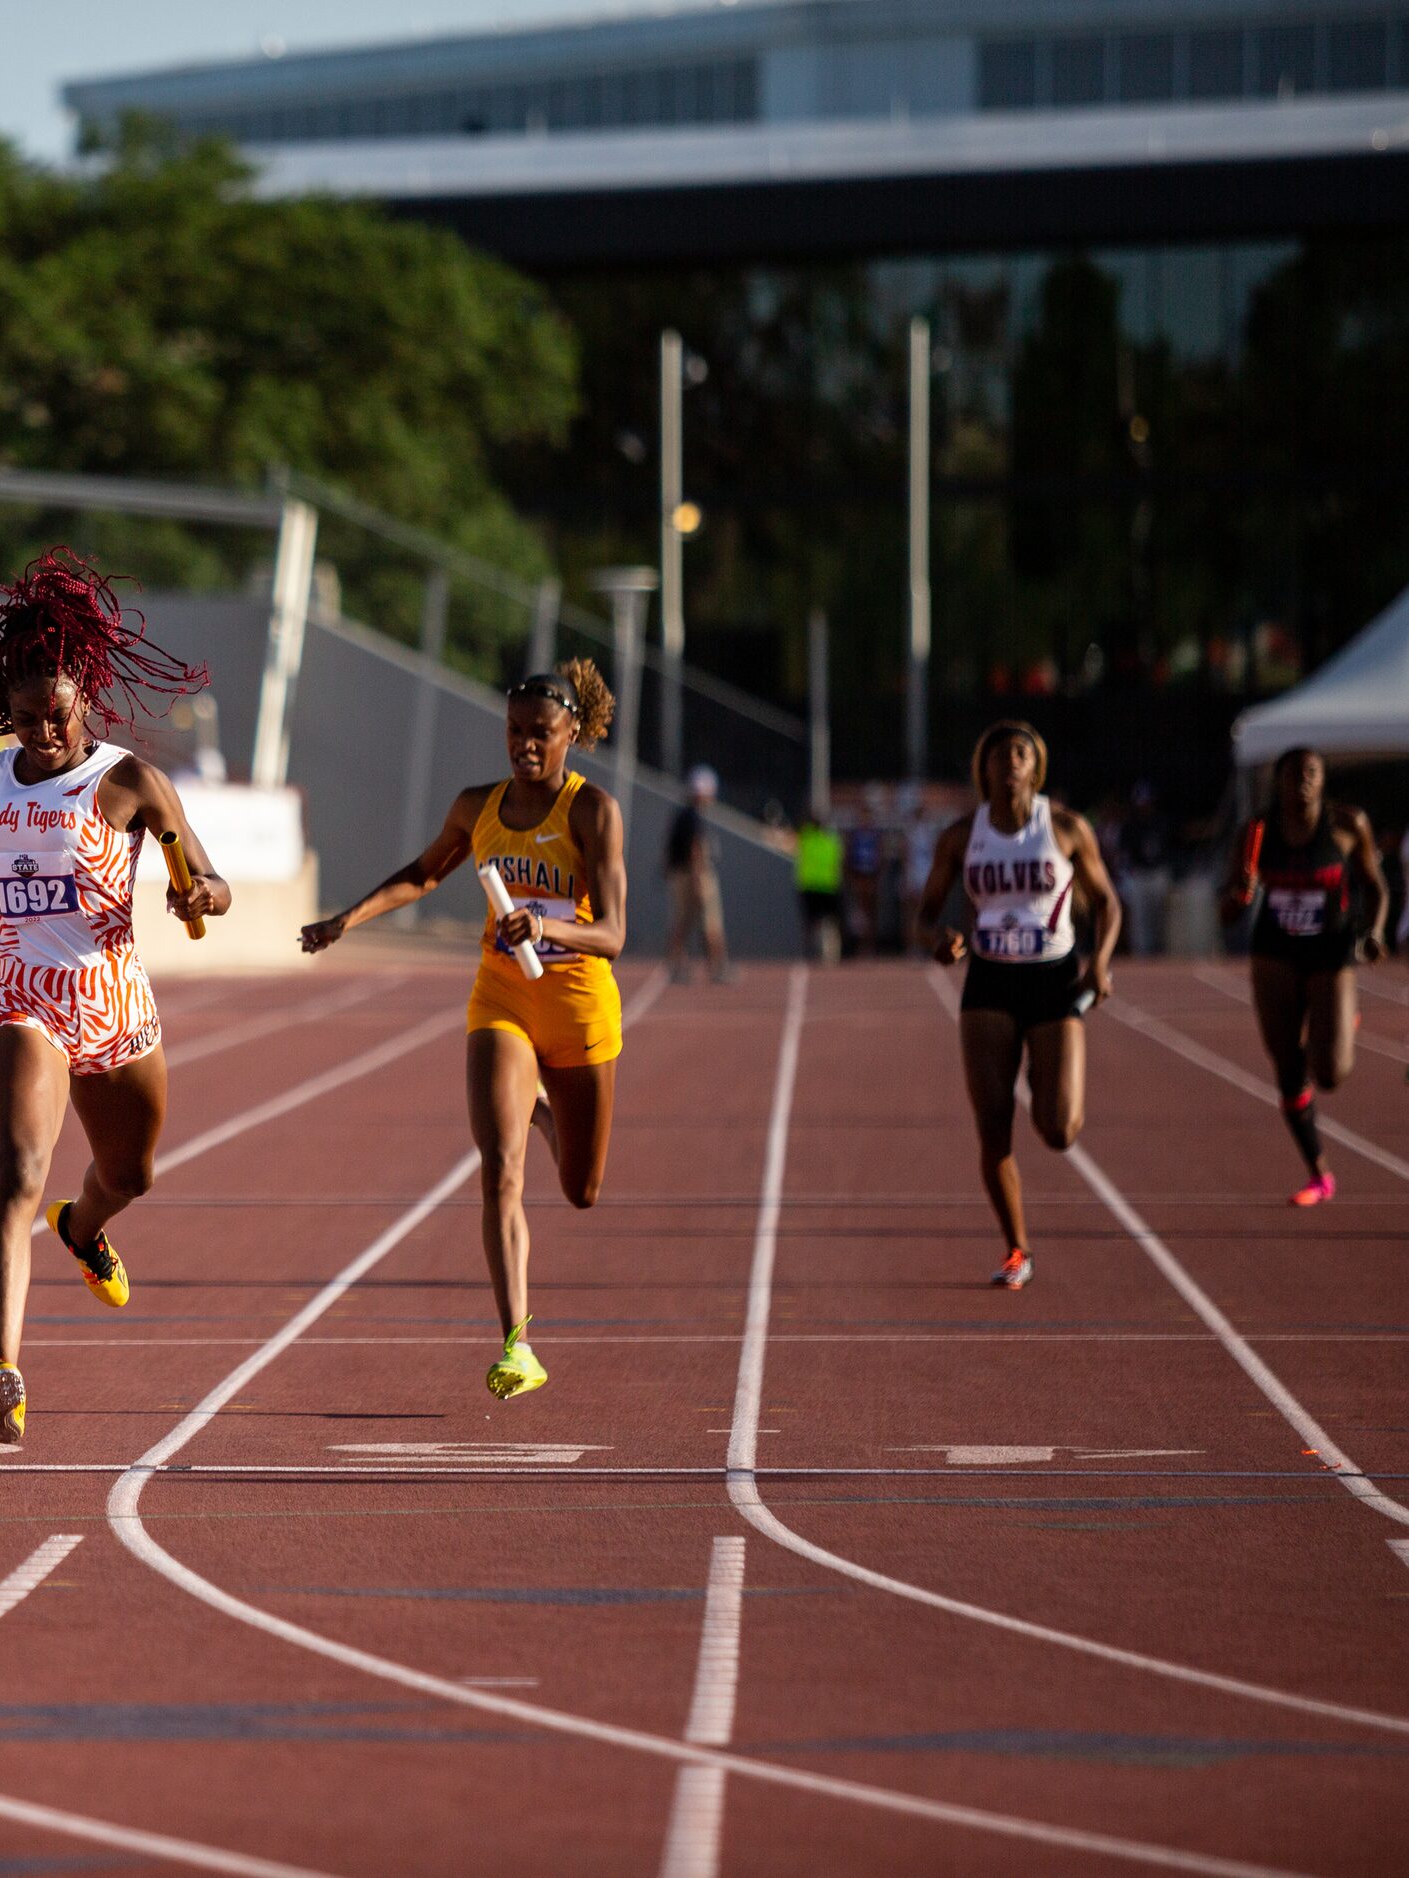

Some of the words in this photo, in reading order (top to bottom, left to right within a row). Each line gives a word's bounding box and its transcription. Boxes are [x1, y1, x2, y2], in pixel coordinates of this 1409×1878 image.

[26, 801, 77, 834] Tigers
[11, 863, 39, 872] STATE
[967, 860, 1056, 895] WOLVES
